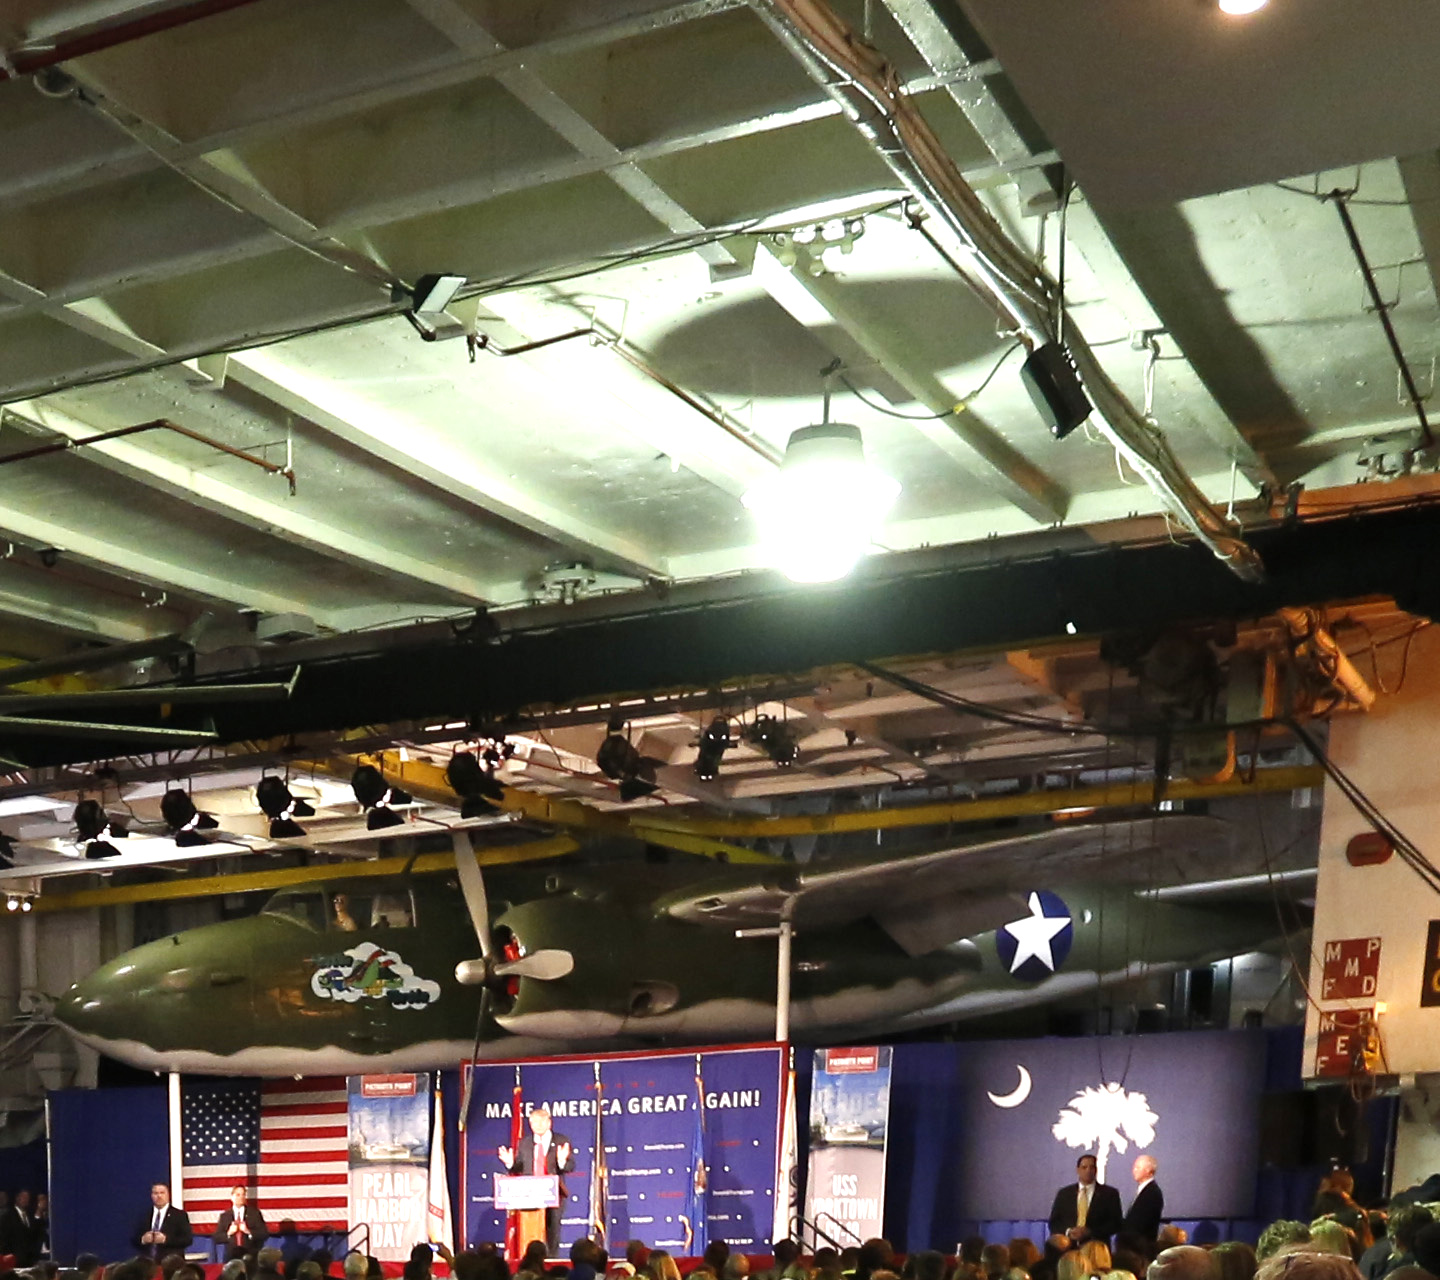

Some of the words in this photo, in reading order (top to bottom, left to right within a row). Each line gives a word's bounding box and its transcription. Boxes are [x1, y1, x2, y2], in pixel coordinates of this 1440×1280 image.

[541, 1099, 623, 1118] AMERICA
[628, 1094, 688, 1114] GREAT
[691, 1089, 760, 1111] GAIN!
[362, 1173, 413, 1198] PEARL
[832, 1174, 858, 1197] USS
[372, 1224, 405, 1248] DAY
